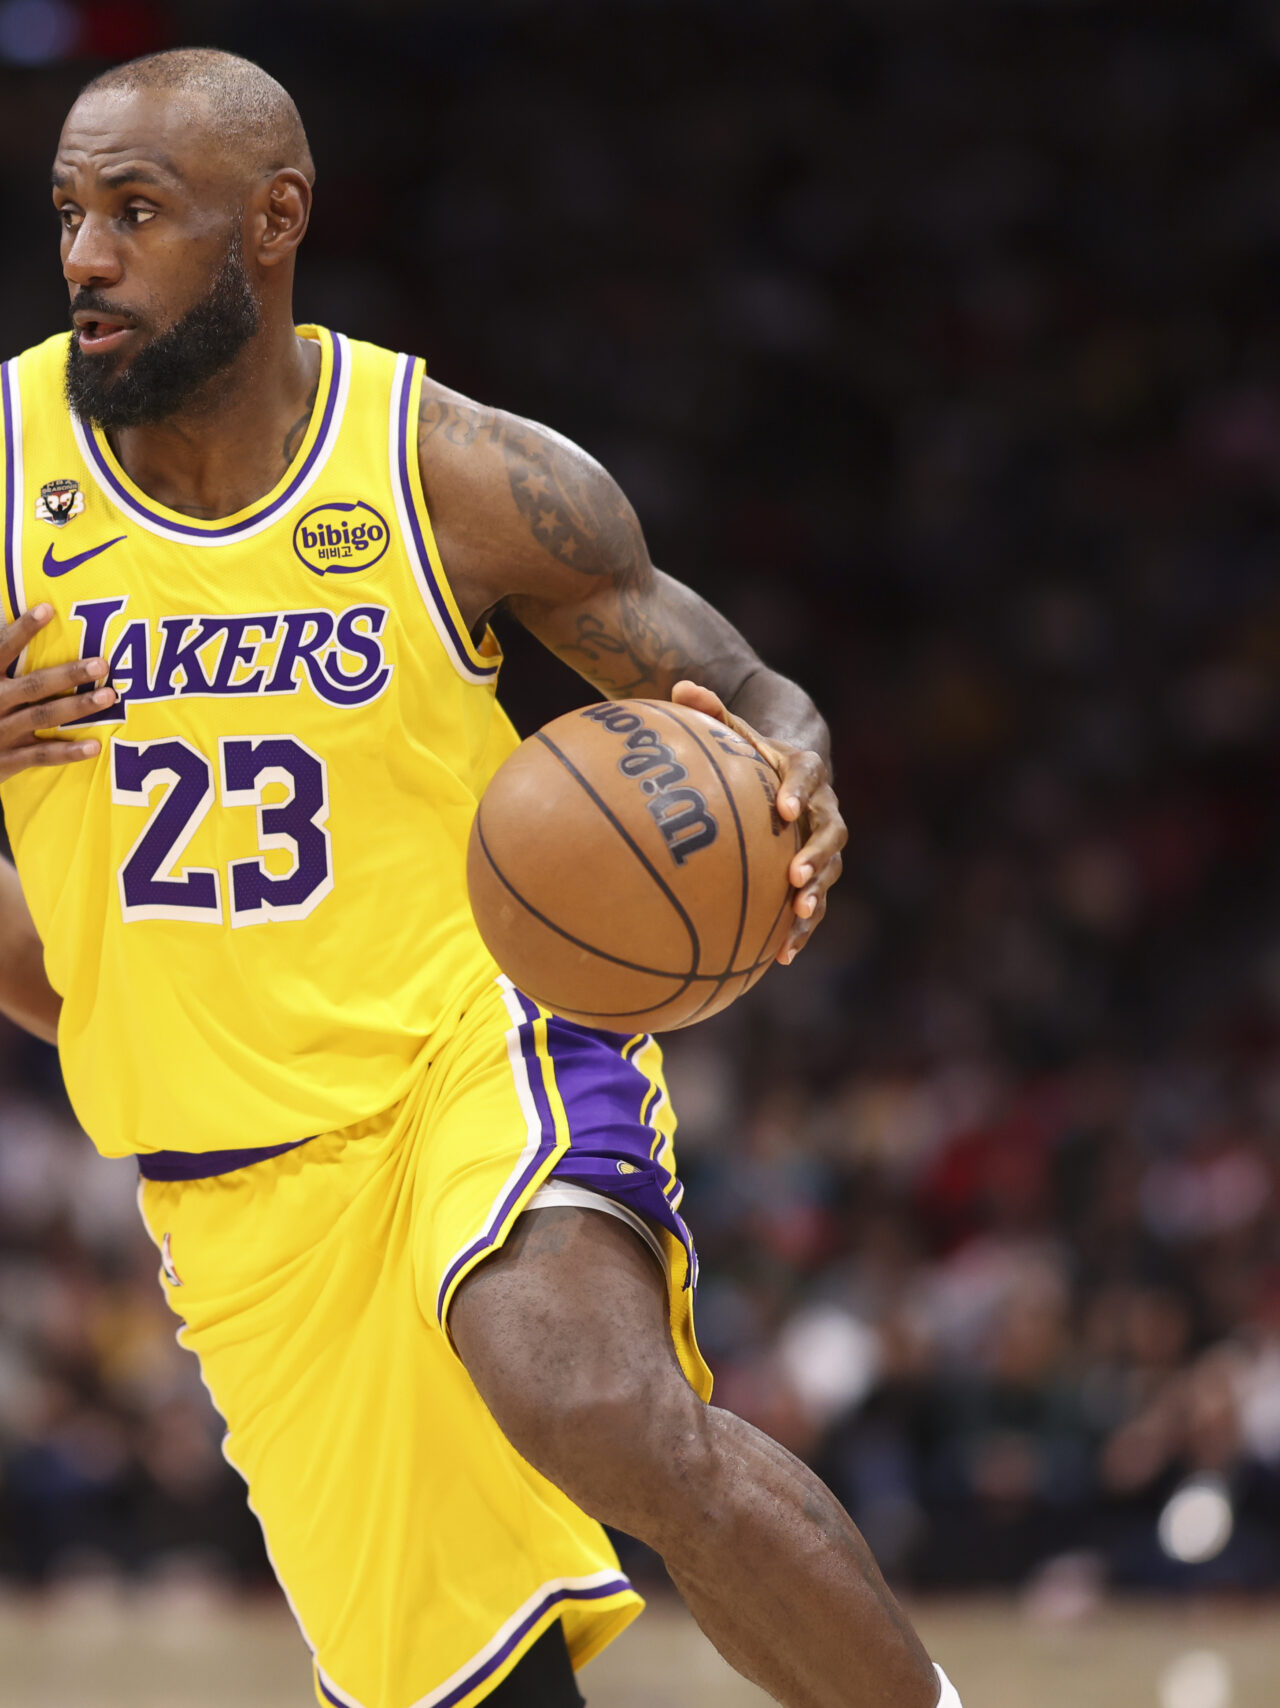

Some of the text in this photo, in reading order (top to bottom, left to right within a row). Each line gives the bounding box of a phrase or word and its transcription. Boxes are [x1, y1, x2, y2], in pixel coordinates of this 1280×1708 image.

[301, 521, 383, 550] bibigo
[318, 546, 352, 559] 비비고
[57, 594, 395, 731] LAKERS
[110, 734, 335, 929] 23
[581, 702, 719, 868] Wilson
